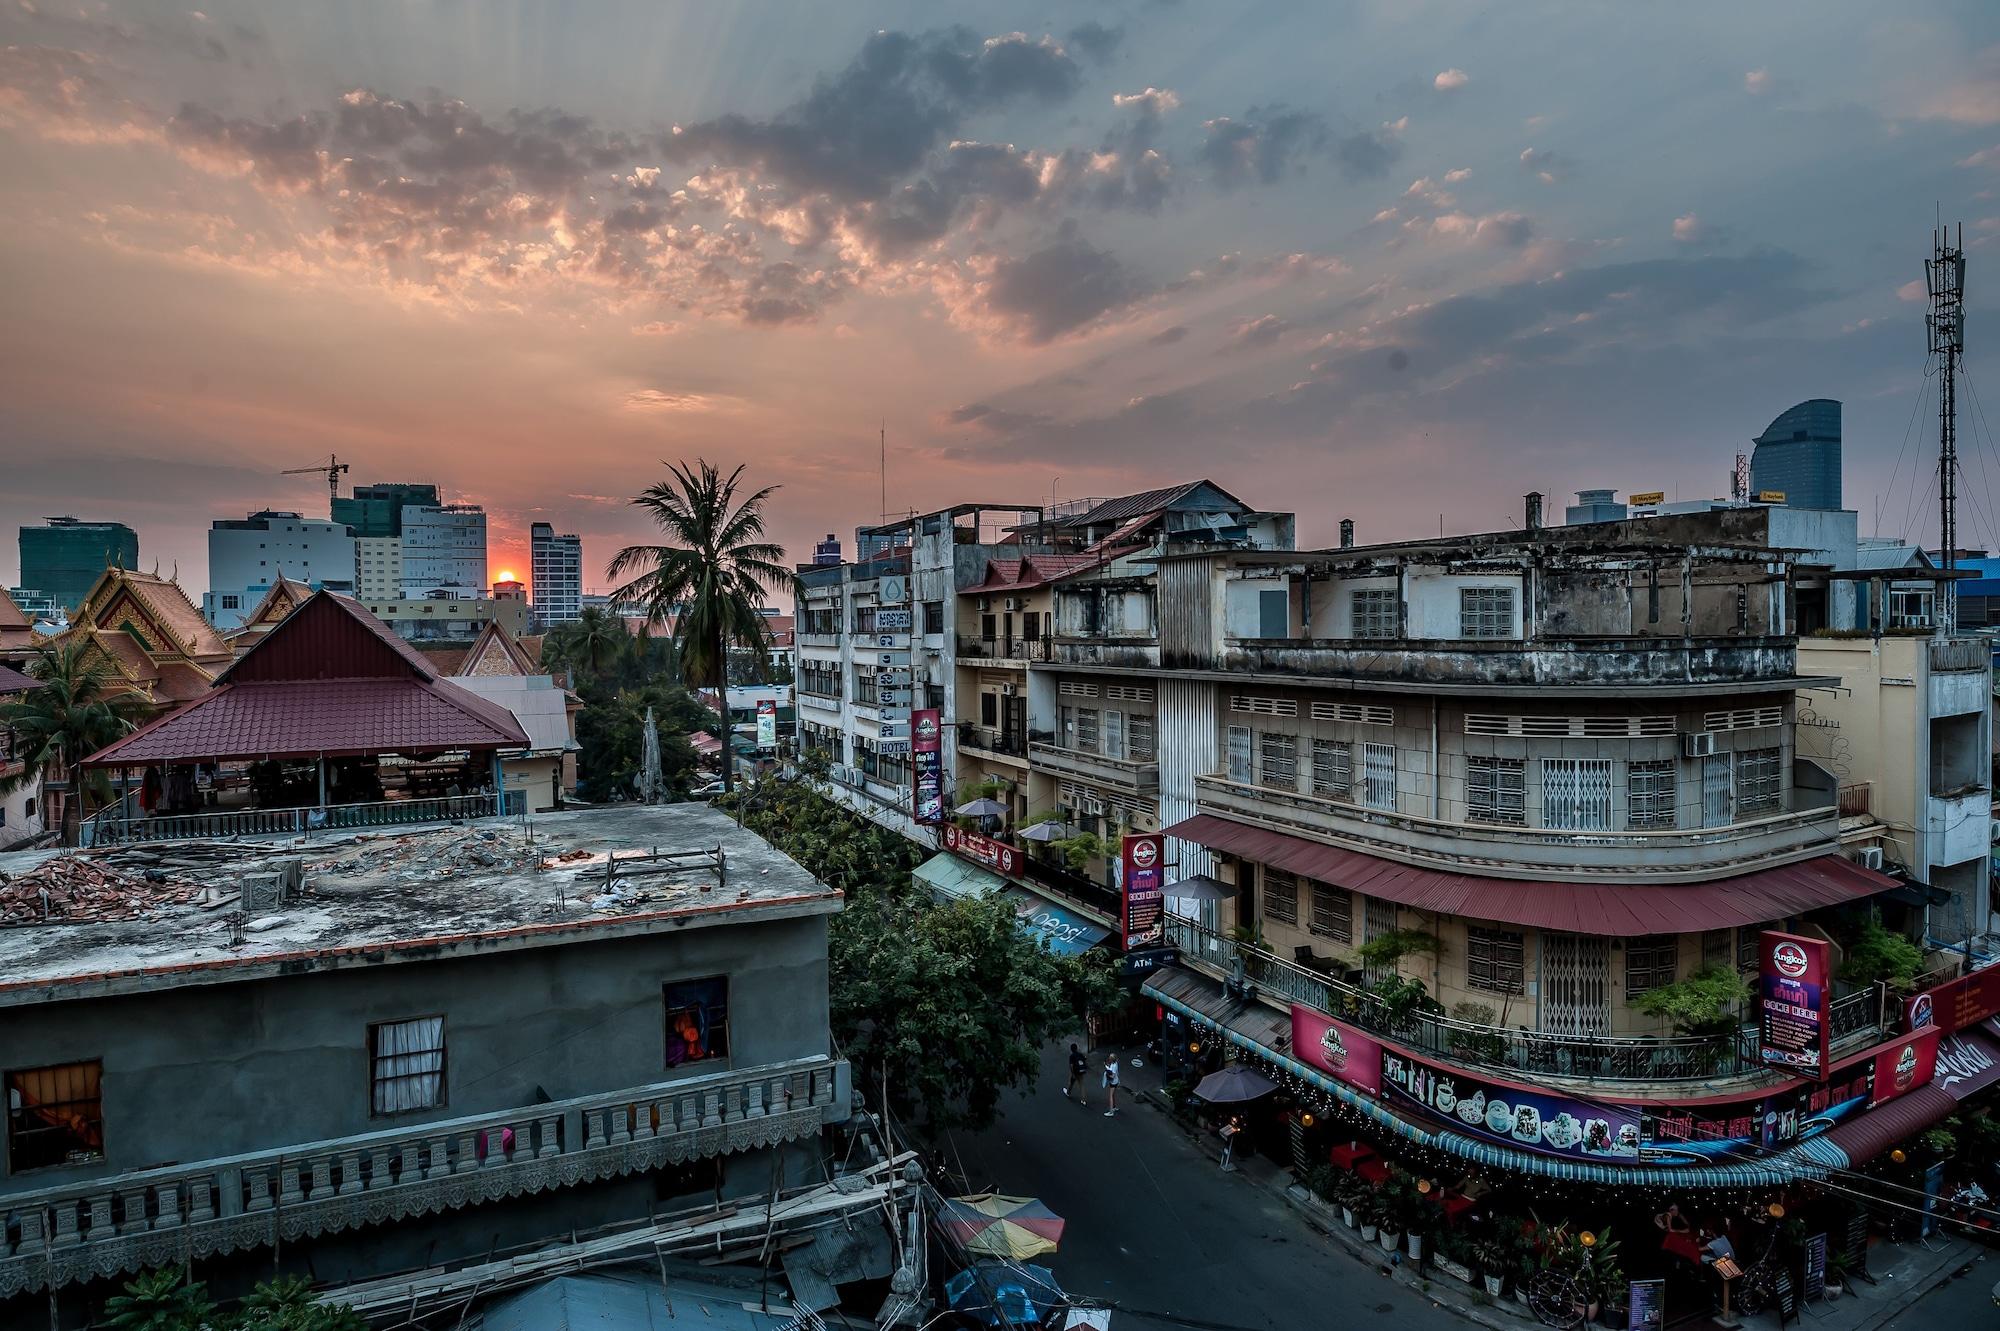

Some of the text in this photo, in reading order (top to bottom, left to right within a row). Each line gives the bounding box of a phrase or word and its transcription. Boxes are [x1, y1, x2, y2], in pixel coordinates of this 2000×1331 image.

[881, 741, 910, 753] HOTEL
[1134, 957, 1152, 968] ATM
[1774, 951, 1808, 967] Angkor
[1320, 1036, 1348, 1056] Angkor
[1895, 1057, 1917, 1074] Angkor
